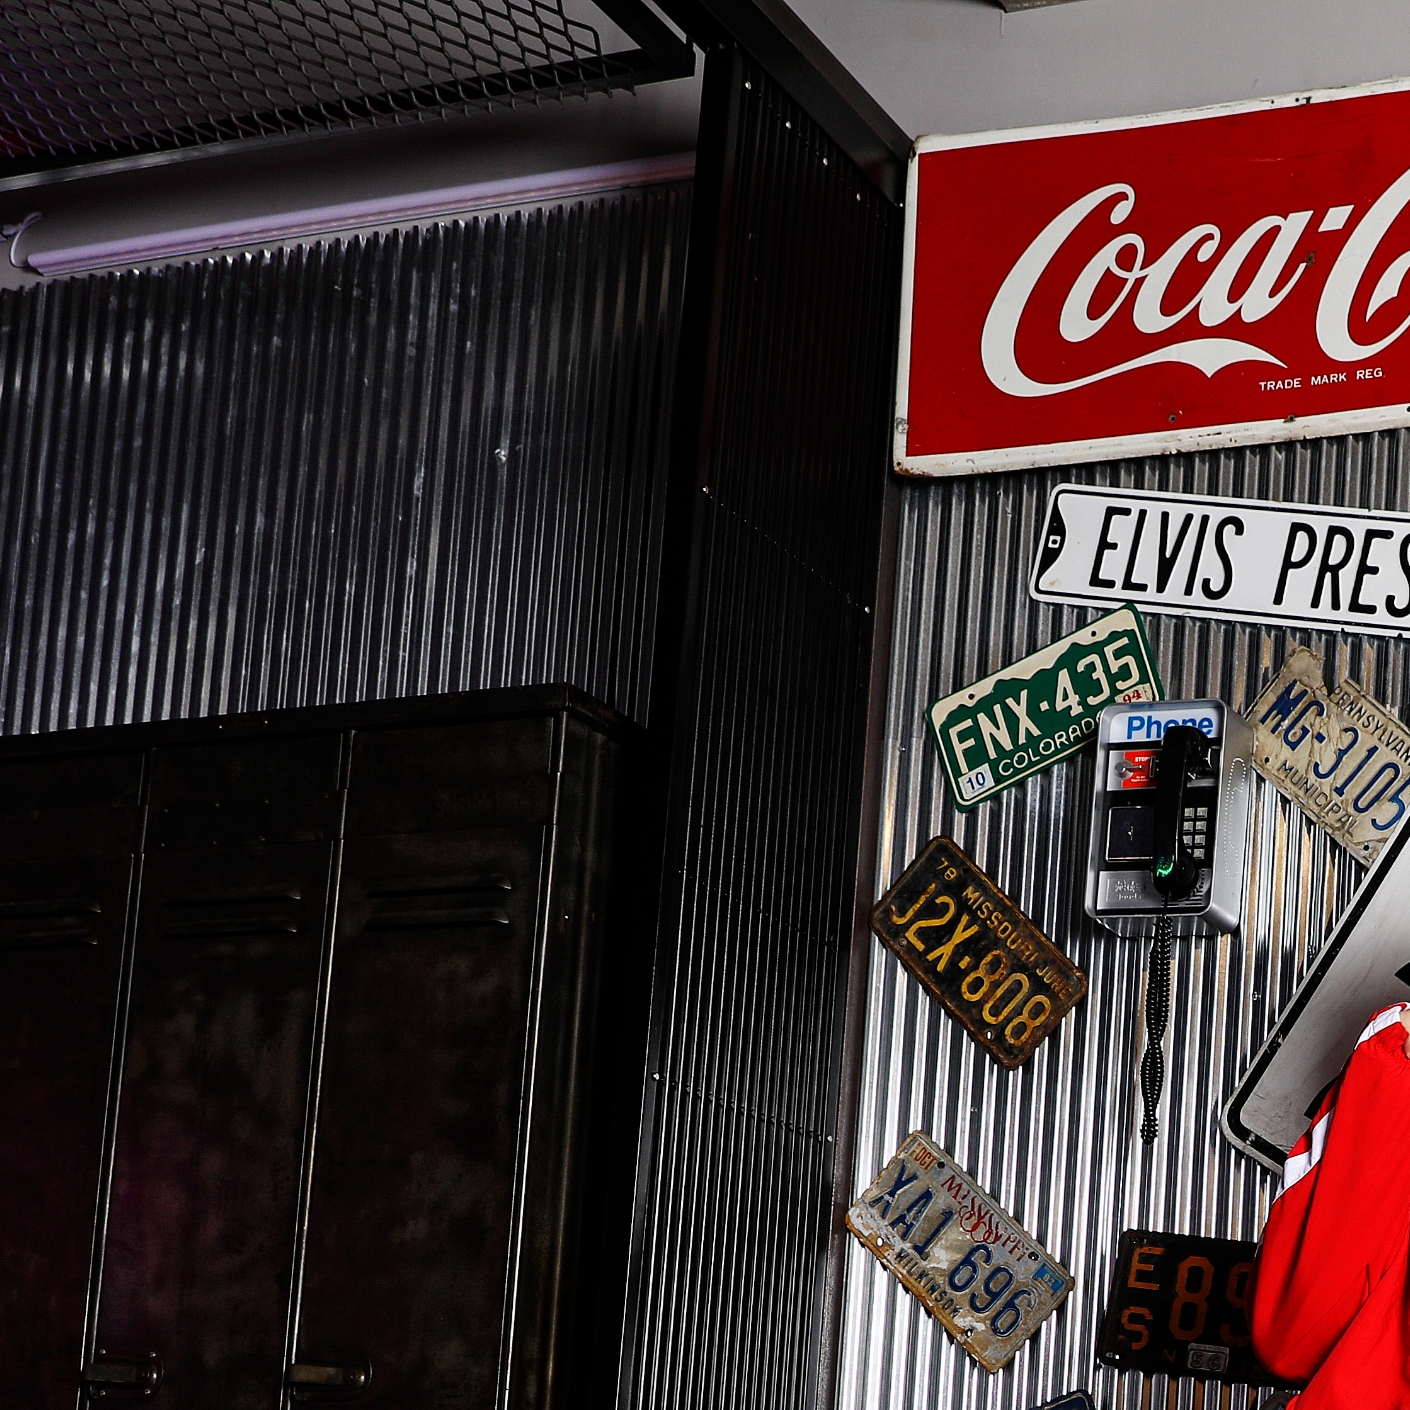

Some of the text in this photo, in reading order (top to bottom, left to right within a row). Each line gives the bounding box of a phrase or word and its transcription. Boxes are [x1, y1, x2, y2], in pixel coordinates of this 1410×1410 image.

[1259, 367, 1386, 392] TRADE MARK REG.
[1088, 505, 1245, 601] ELVIS
[1122, 689, 1143, 703] 94
[966, 772, 986, 792] 10
[1279, 759, 1360, 834] MUNICIPAL
[935, 857, 957, 881] 78
[962, 885, 1073, 1001] MISSOURI JUNE
[914, 1147, 938, 1170] OCT
[948, 1243, 1035, 1338] 696
